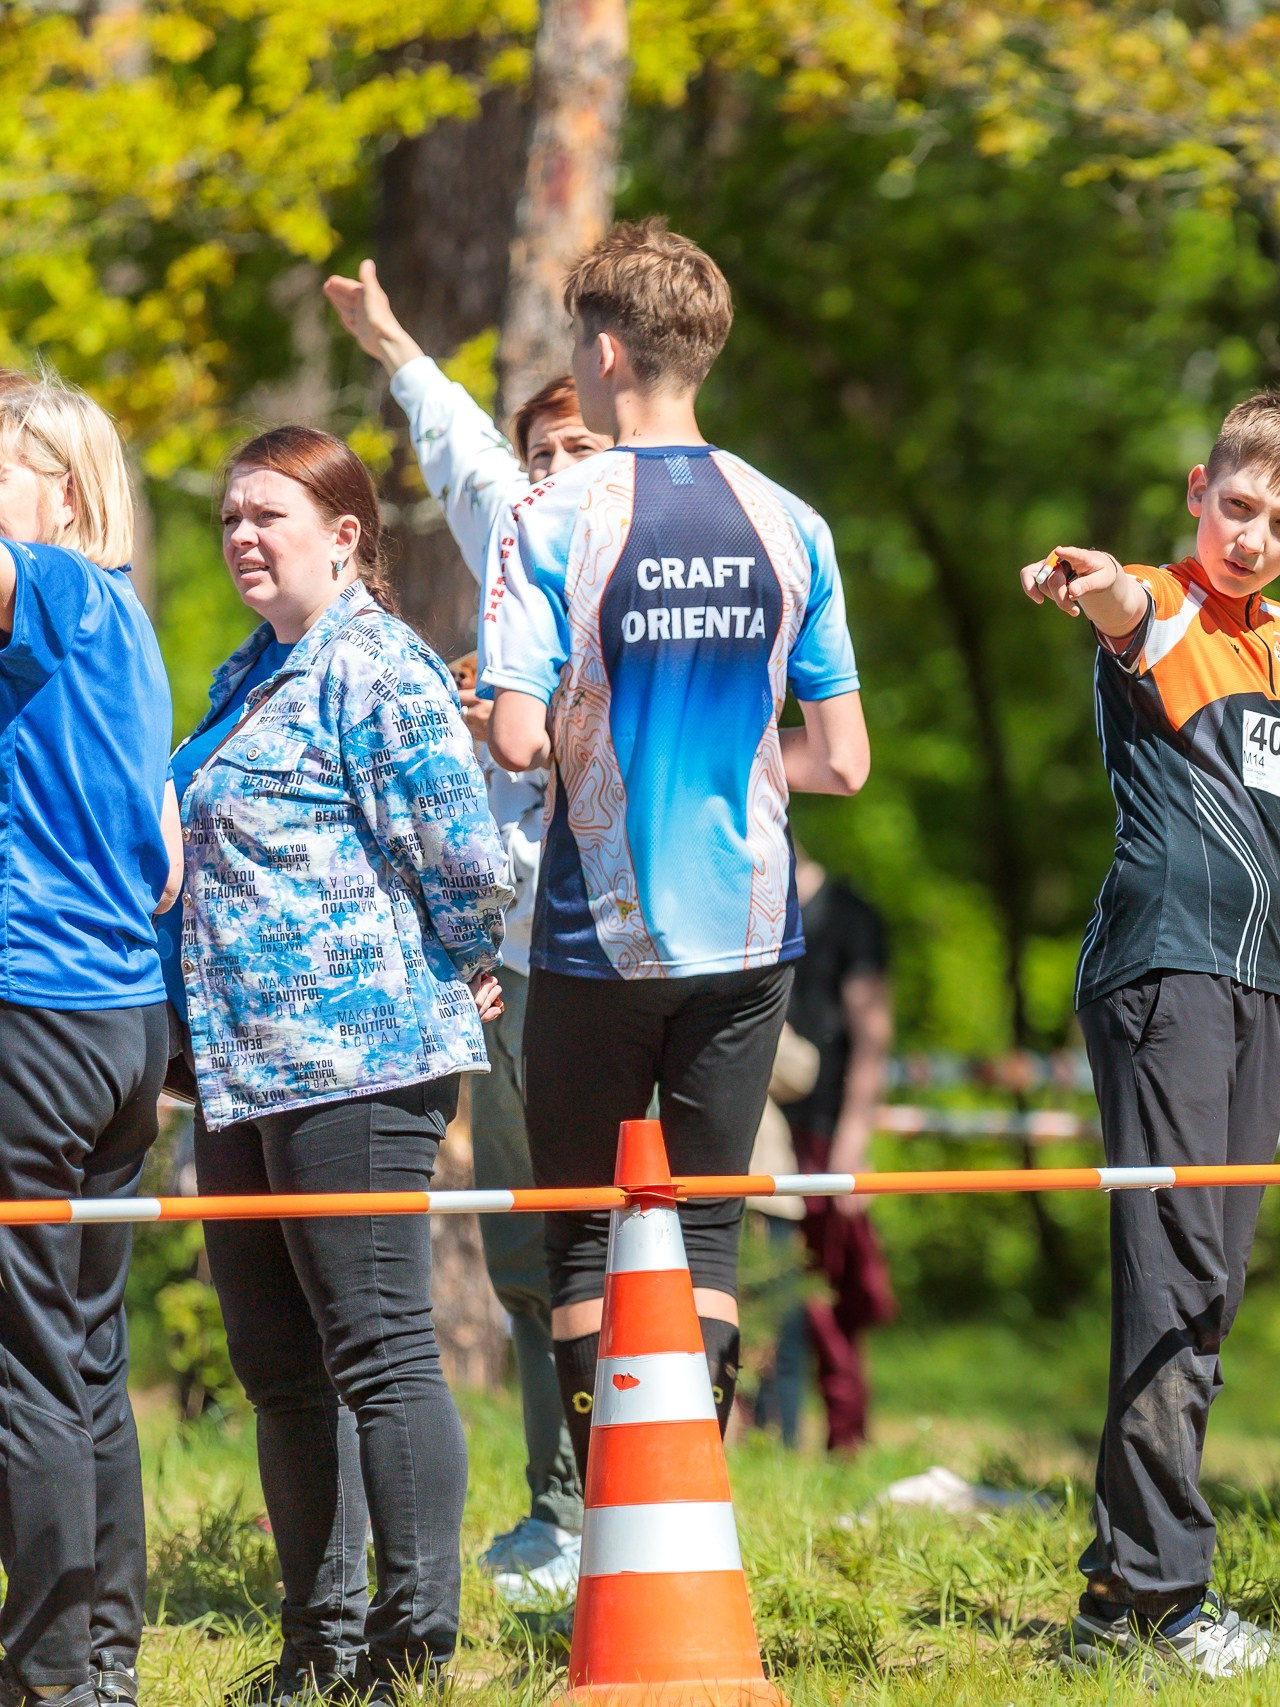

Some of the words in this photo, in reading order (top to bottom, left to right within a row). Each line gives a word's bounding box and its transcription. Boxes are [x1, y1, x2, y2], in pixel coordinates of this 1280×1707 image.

[636, 556, 756, 592] CRAFT
[621, 606, 766, 644] ORIENTA
[393, 712, 448, 733] BEAUTIFUL
[1243, 750, 1265, 768] M14
[418, 786, 477, 809] BEAUTIFUL
[421, 800, 479, 822] TODAY
[266, 853, 311, 863] BEAUTIFUL
[268, 862, 311, 872] TODAY
[434, 858, 493, 875] TODAY
[317, 873, 376, 889] TODAY
[436, 872, 496, 888] BEAUTIFUL
[204, 884, 259, 900] BEAUTIFUL
[317, 886, 375, 901] BEAUTIFUL
[205, 898, 260, 913] TODAY
[258, 923, 301, 934] TODAY
[258, 932, 301, 943] BEAUTIFUL
[323, 933, 381, 948] TODAY
[324, 947, 384, 961] BEAUTIFUL
[208, 975, 244, 986] TODAY
[261, 988, 323, 1004] BEAUTIFUL
[265, 1001, 323, 1017] TODAY
[206, 1024, 260, 1041] TODAY
[340, 1017, 400, 1036] BEAUTIFUL
[206, 1038, 263, 1055] BEAUTIFUL
[341, 1030, 401, 1049] TODAY
[294, 1068, 337, 1081] BEAUTIFUL
